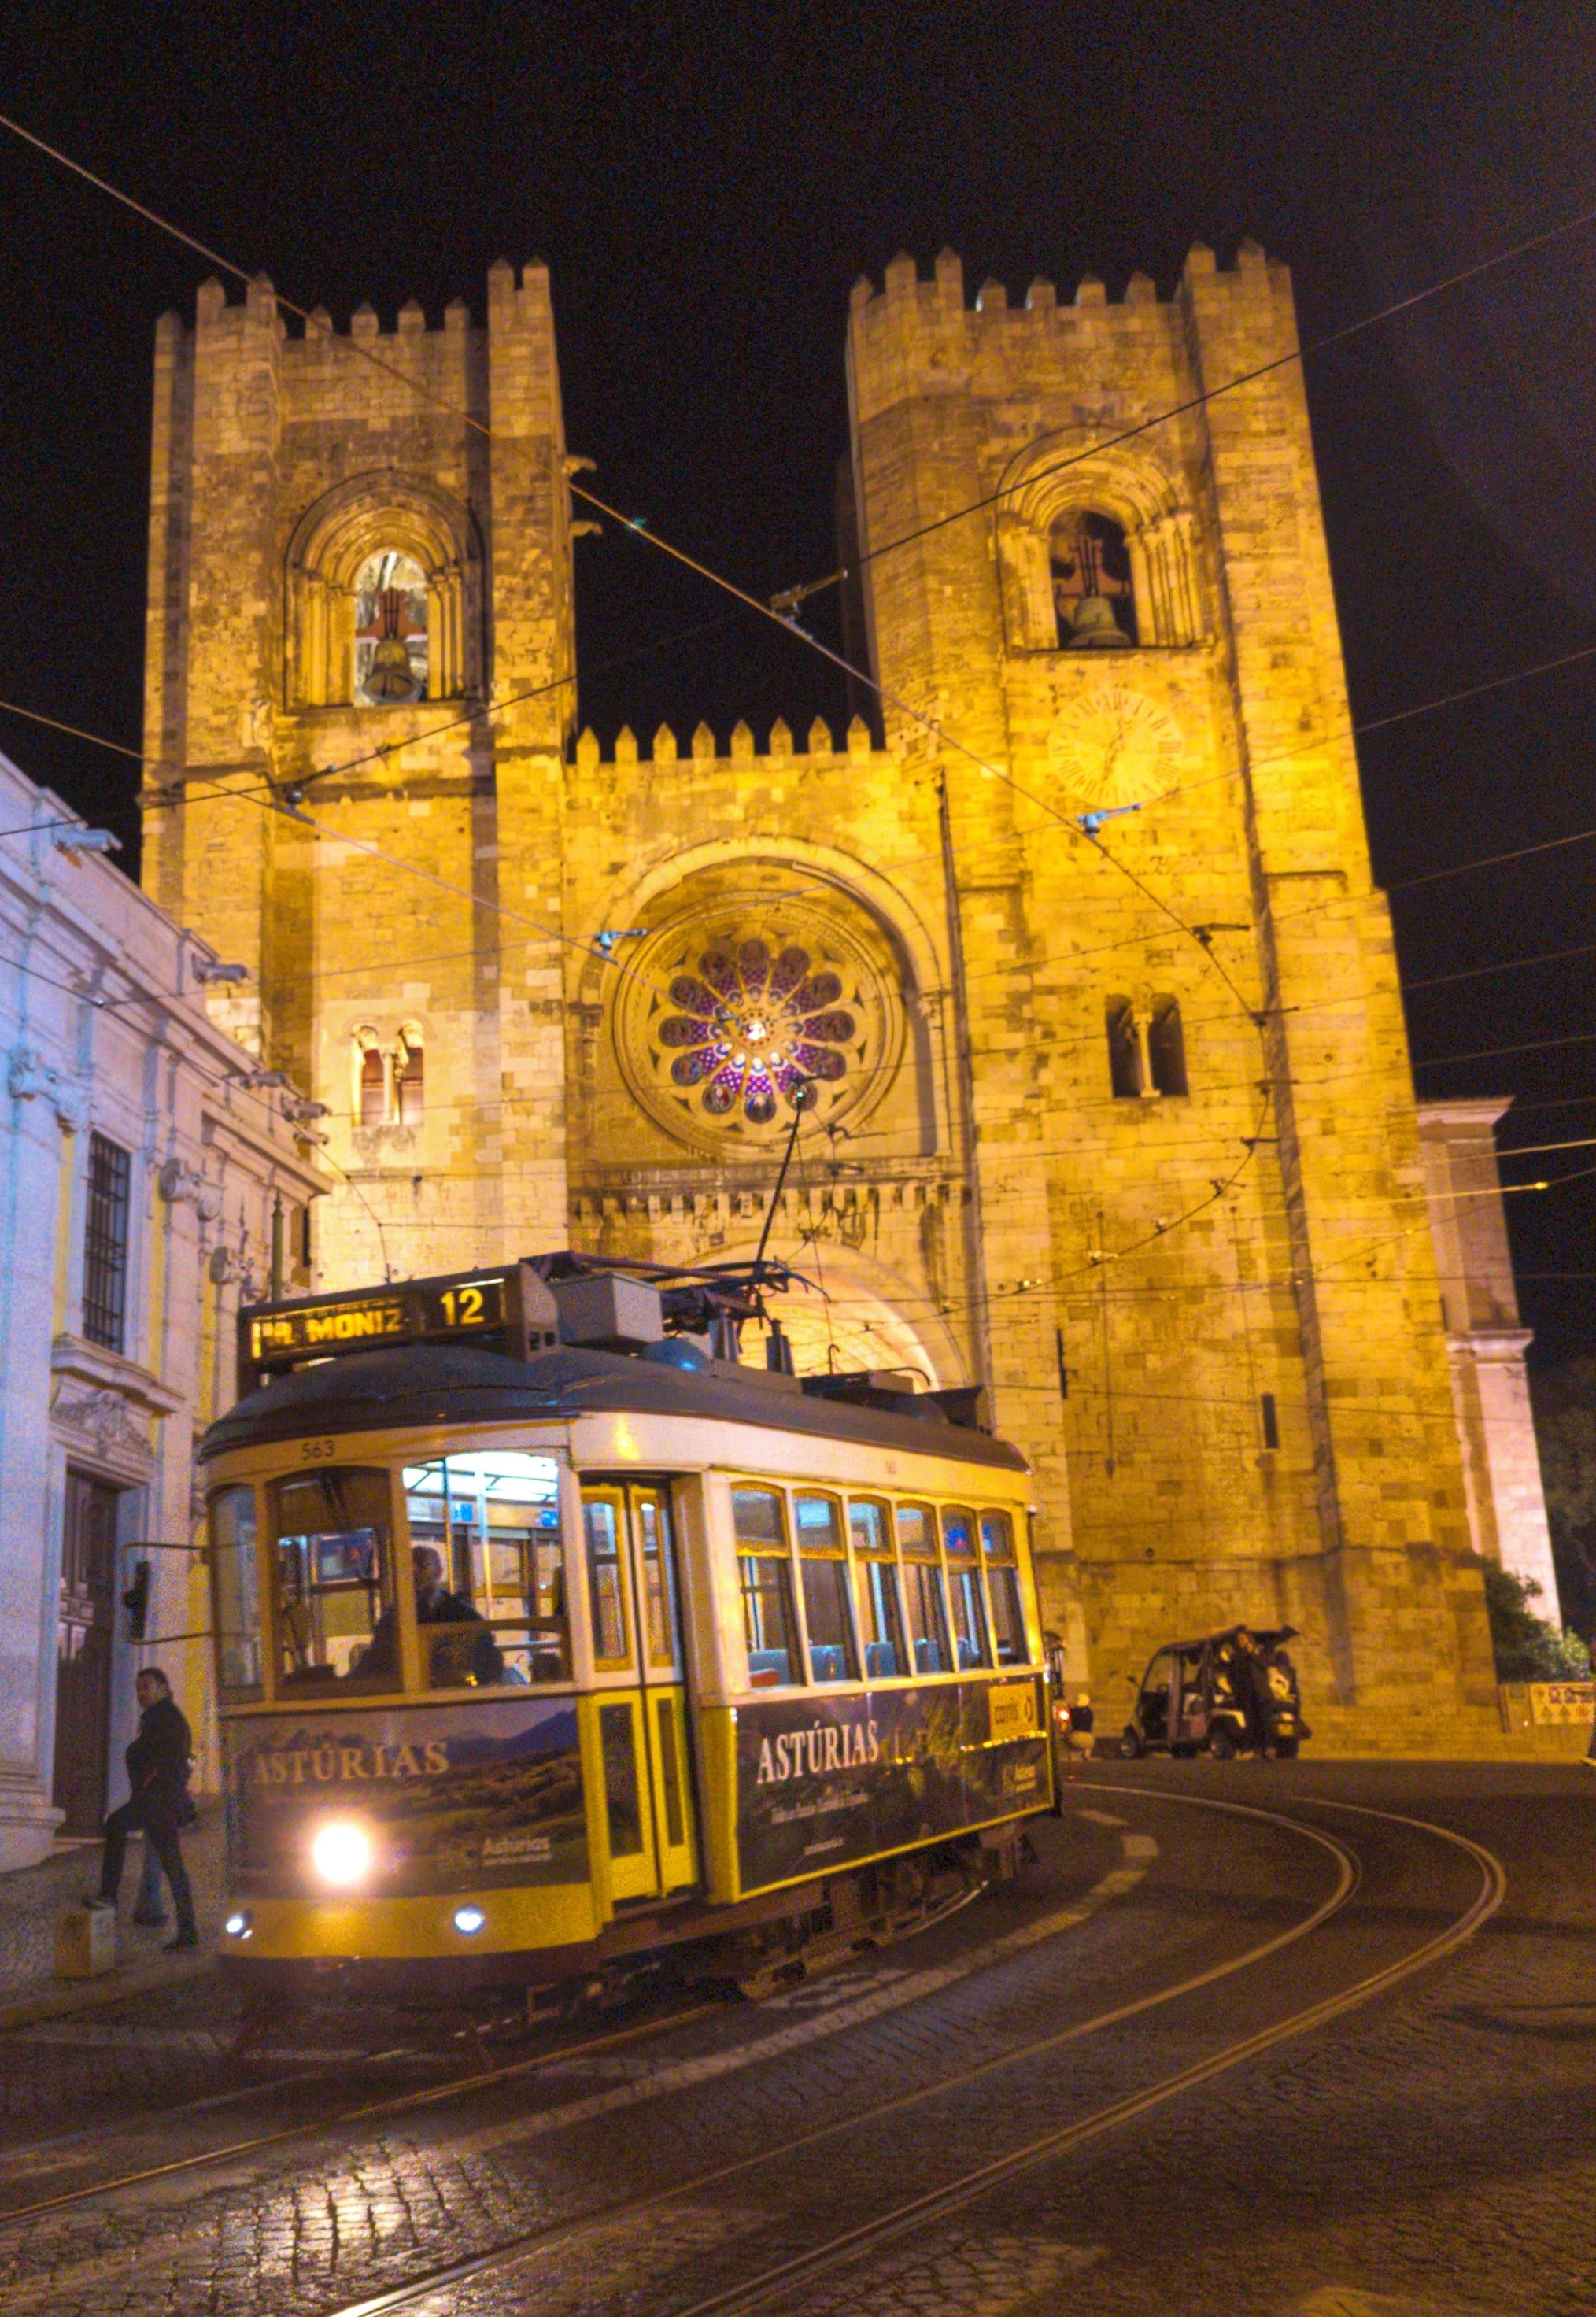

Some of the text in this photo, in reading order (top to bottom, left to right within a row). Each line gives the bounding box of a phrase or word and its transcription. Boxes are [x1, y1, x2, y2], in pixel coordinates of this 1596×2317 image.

[306, 1307, 403, 1343] MONIZ
[441, 1288, 485, 1326] 12
[301, 1439, 335, 1461] 563
[253, 1741, 449, 1784] ASTÚRIAS
[756, 1720, 879, 1784] ASTÚRIAS
